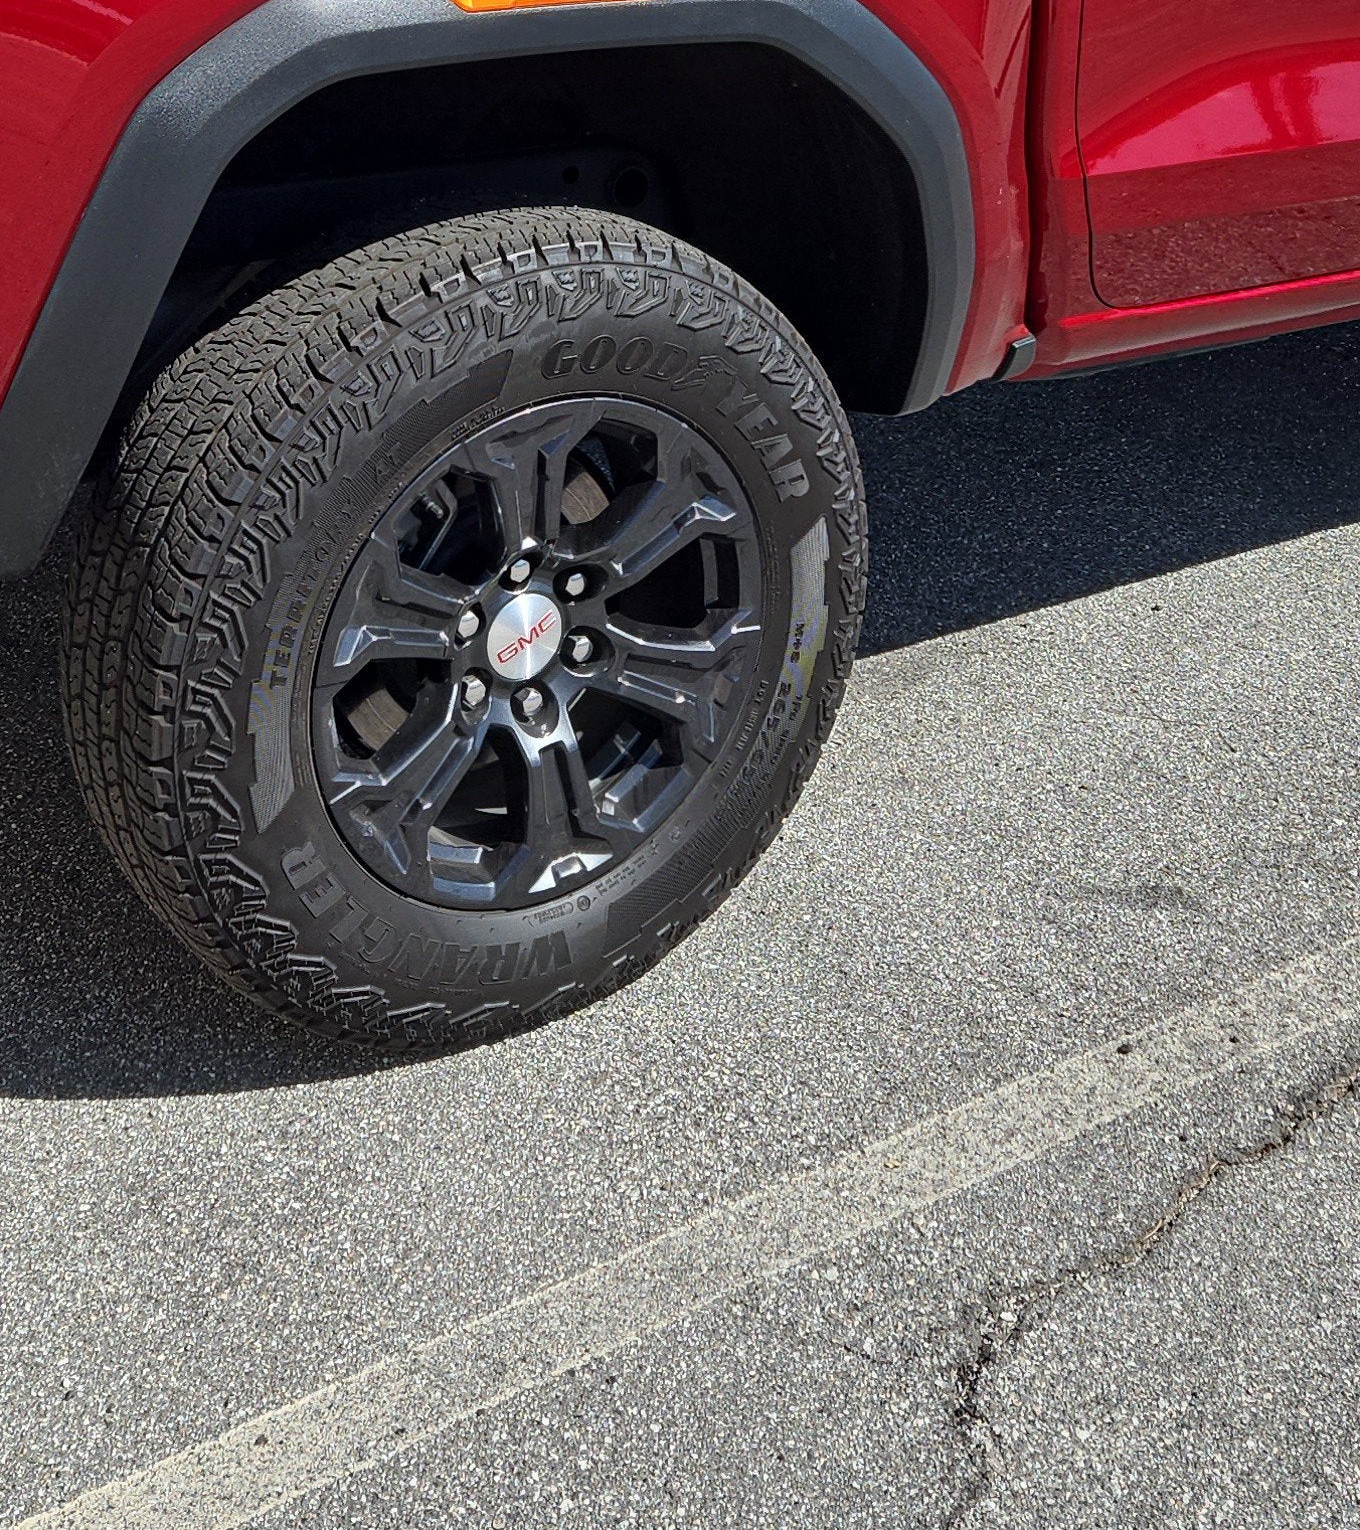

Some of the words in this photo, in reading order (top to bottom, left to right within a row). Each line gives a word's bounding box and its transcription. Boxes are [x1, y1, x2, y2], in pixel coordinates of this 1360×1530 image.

[541, 334, 810, 504] GOODYEAR
[497, 610, 557, 664] GMC
[281, 841, 572, 986] WRANGLER
